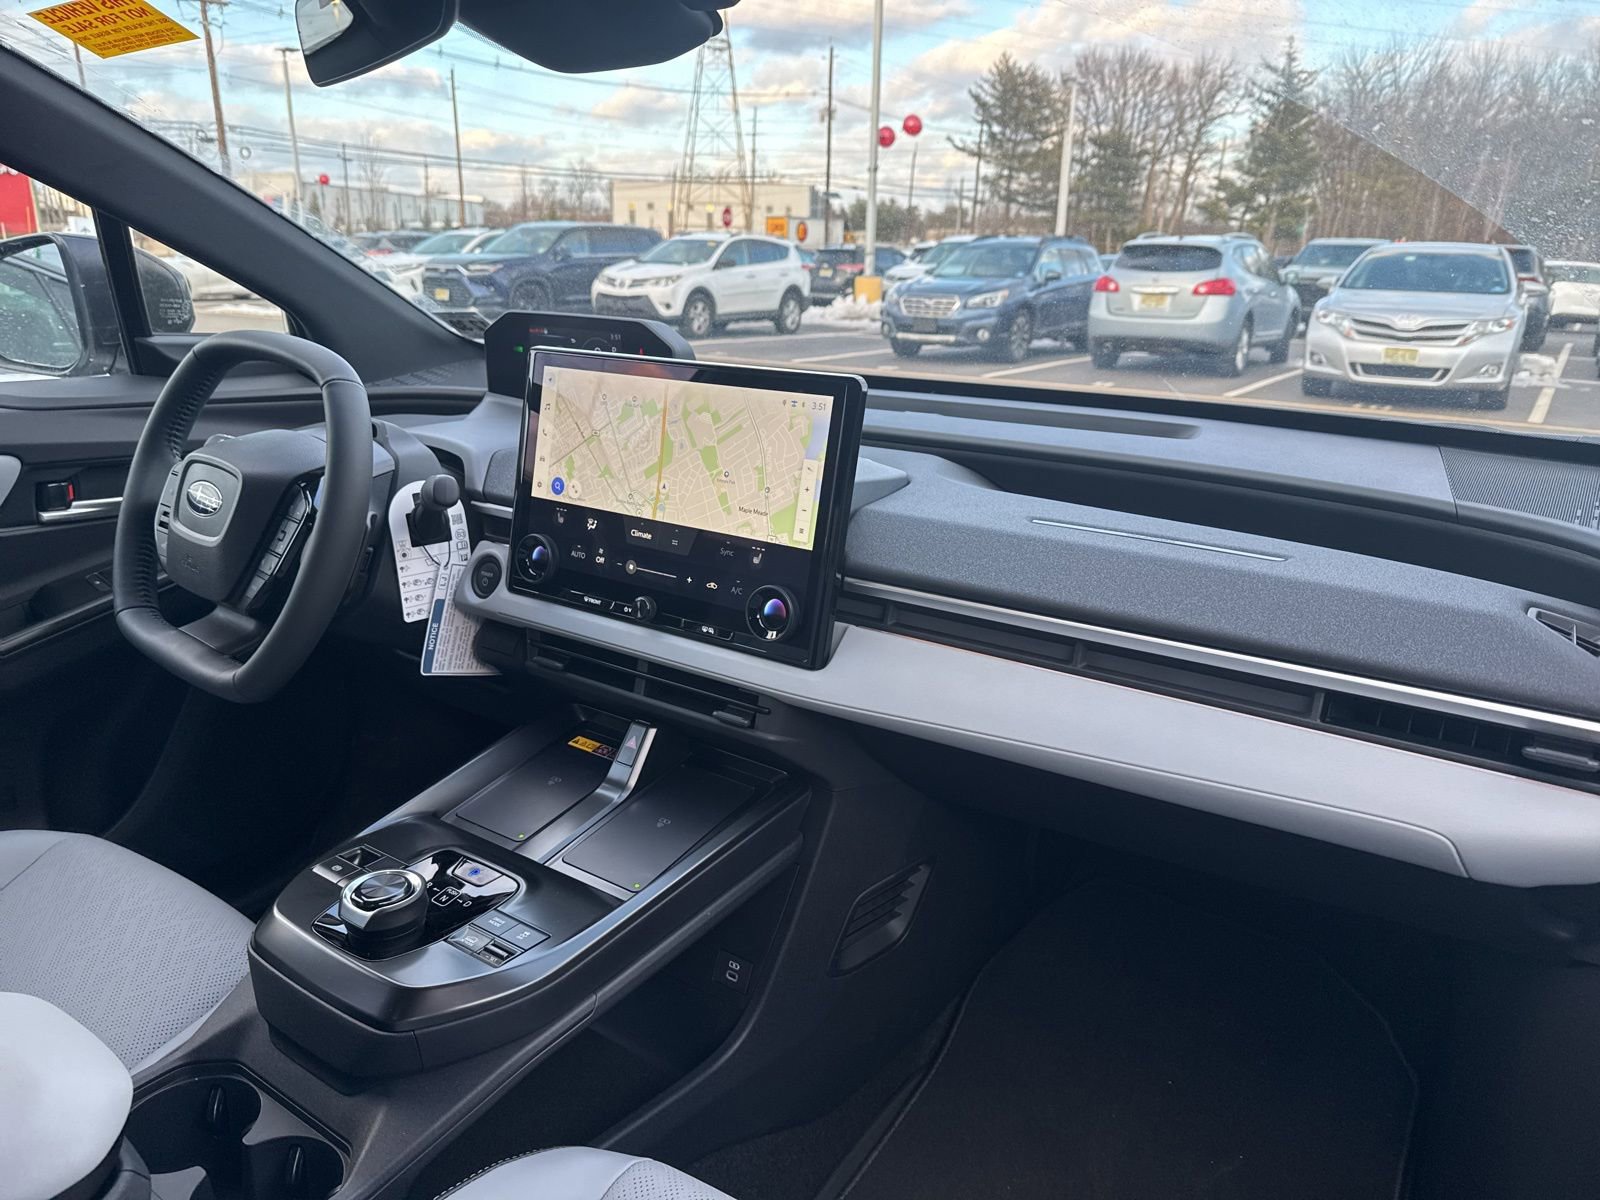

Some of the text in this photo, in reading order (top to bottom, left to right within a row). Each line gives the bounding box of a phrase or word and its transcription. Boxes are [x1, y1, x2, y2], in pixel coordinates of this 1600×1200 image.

[738, 505, 752, 515] Maple
[630, 528, 652, 540] Climate
[570, 550, 586, 560] AUTO
[720, 547, 734, 558] Sync
[595, 555, 605, 565] Off
[730, 586, 743, 596] A/C
[427, 622, 440, 651] NOTICE
[462, 900, 472, 908] D
